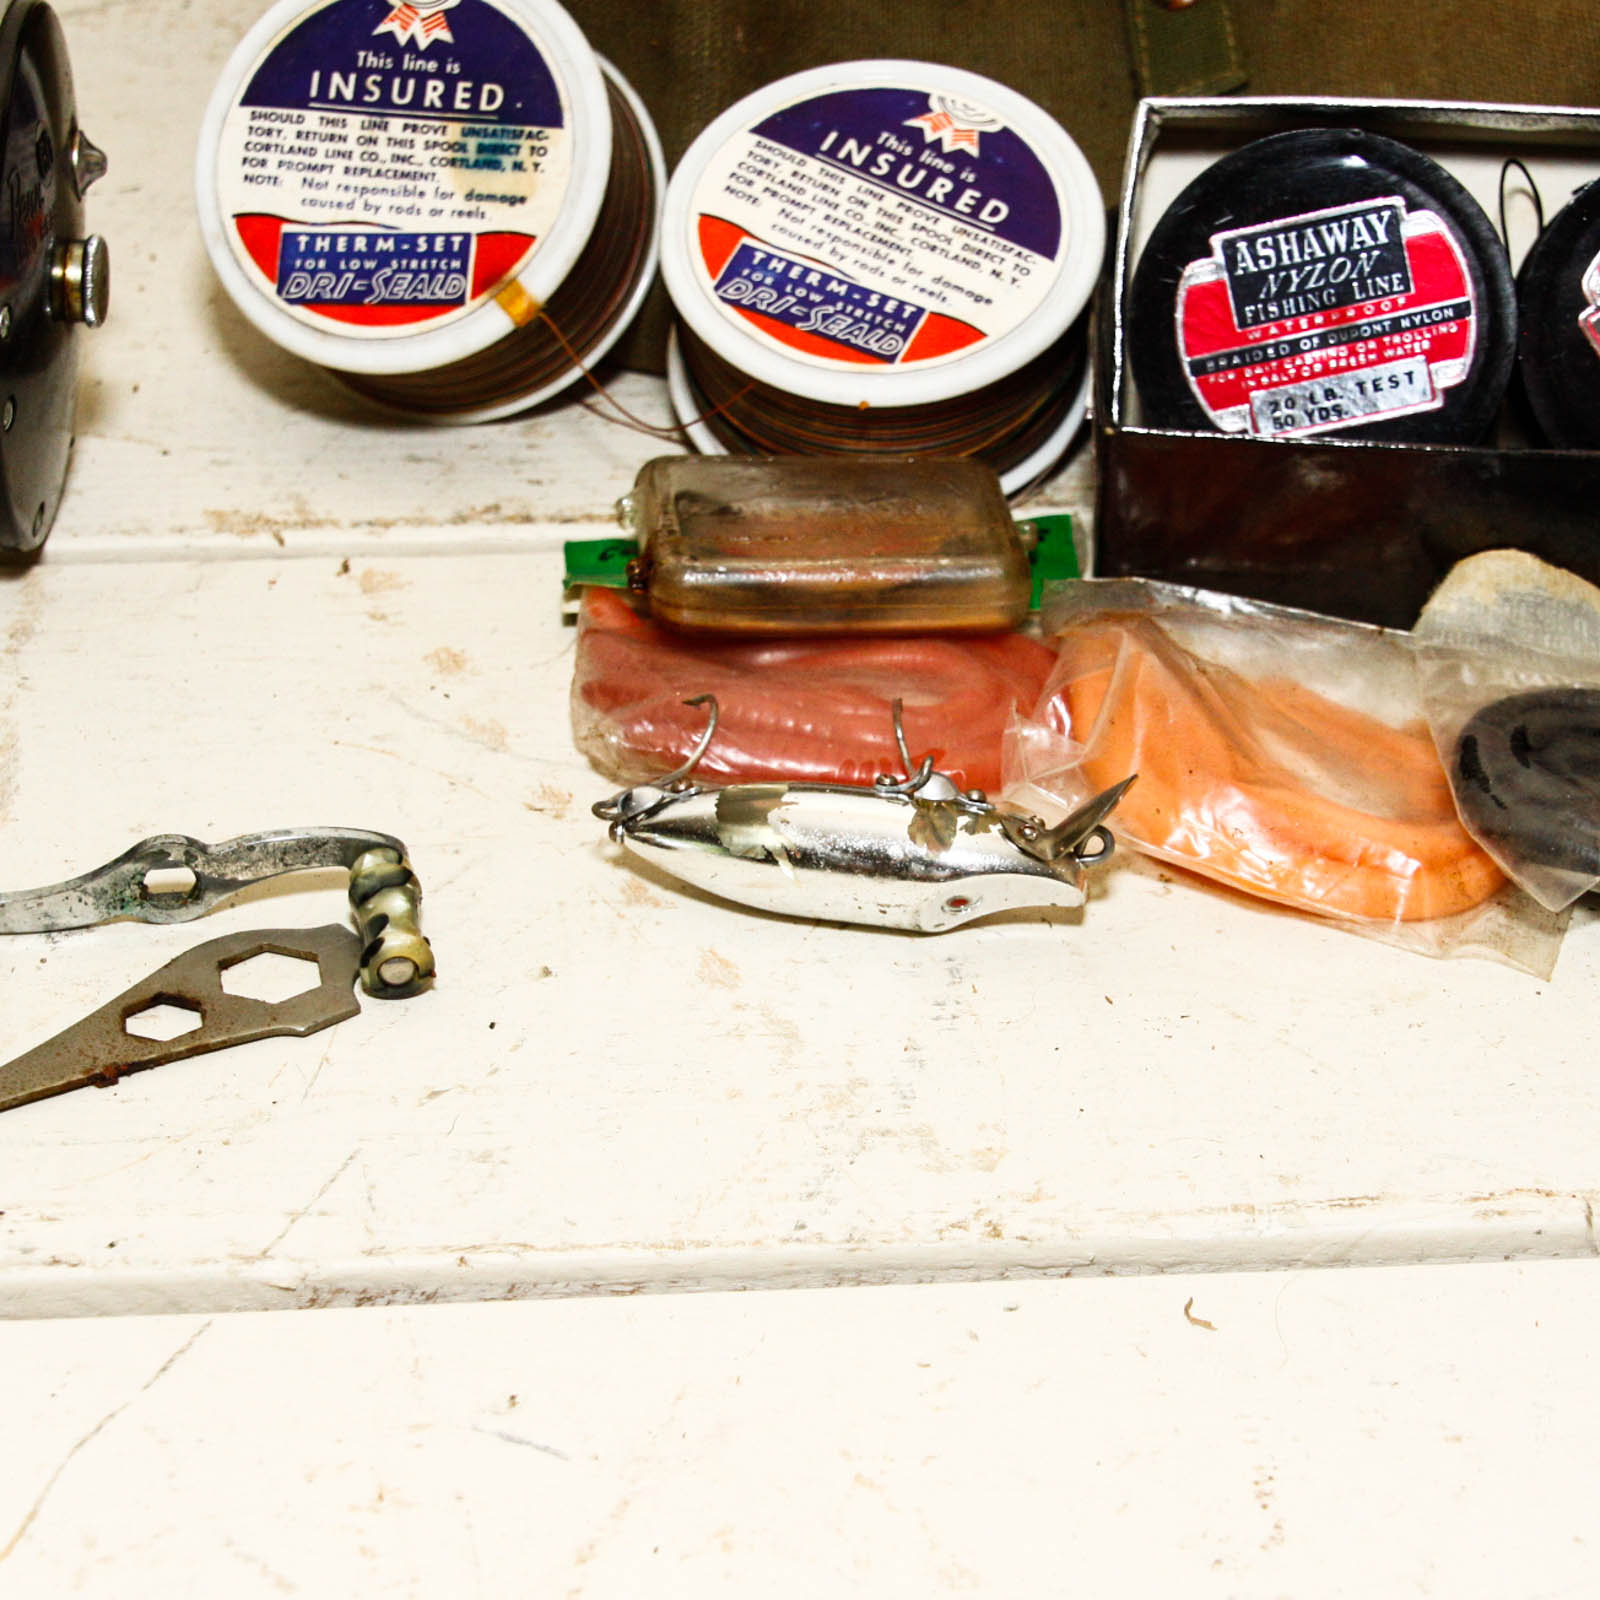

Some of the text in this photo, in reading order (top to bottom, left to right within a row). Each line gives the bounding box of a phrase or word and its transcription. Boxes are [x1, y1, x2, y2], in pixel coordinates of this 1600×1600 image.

[357, 51, 461, 75] This line is
[309, 70, 505, 112] INSURED
[248, 126, 548, 157] TORY, RETURN ON THIS SPOOL DIRECT TO
[250, 110, 550, 141] SHOULD THIS LINE PROVE UNSATISFAC-
[241, 157, 441, 183] FOR PROMPT REPLACEMENT.
[244, 141, 318, 157] CORTLAND
[325, 149, 353, 161] LINE
[430, 156, 506, 172] CORTLAND,
[512, 161, 527, 173] N.
[532, 162, 545, 174] Y.
[819, 130, 1010, 225] INSURED
[876, 131, 977, 183] This line is
[301, 177, 329, 191] Not
[337, 183, 426, 200] responsible
[434, 186, 456, 200] for
[464, 188, 528, 207] damage
[728, 172, 755, 187] FOR
[762, 187, 817, 215] PROMPT
[755, 140, 808, 168] SHOULD
[818, 167, 846, 185] THIS
[857, 185, 886, 202] LINE
[896, 202, 941, 226] PROVE
[301, 198, 356, 211] caused
[363, 200, 382, 215] by
[389, 202, 422, 216] rods
[429, 208, 444, 217] or
[737, 161, 807, 196] CORTLAND
[812, 195, 841, 211] LINE
[989, 269, 1006, 281] N.
[1010, 277, 1022, 289] Y.
[791, 170, 841, 197] RETURN
[847, 195, 870, 209] ON
[876, 207, 904, 225] THIS
[911, 223, 953, 246] SPOOL
[961, 243, 1006, 265] DIRECT
[1013, 263, 1031, 277] TO
[294, 258, 462, 271] FOR LOW STRETCH
[771, 223, 825, 249] caused
[829, 247, 847, 262] by
[853, 259, 886, 277] rods
[891, 276, 907, 285] or
[778, 208, 806, 225] Not
[810, 224, 896, 266] responsible
[903, 261, 924, 277] for
[931, 275, 993, 306] damage
[1234, 209, 1392, 276] ASHAWAY
[281, 267, 466, 305] DRI-SEALD
[742, 268, 907, 333] FOR LOW STRETCH
[1244, 272, 1405, 324] FISHING LINE
[717, 278, 904, 355] DRI-SEALD
[1205, 307, 1455, 372] BRAIDED OF DUPONT NYLON
[1246, 296, 1406, 340] WATERPROOF
[1208, 371, 1236, 384] FOR
[1283, 345, 1349, 369] CASTING
[1355, 339, 1378, 353] OR
[1382, 322, 1459, 346] TROLLING
[1260, 367, 1298, 386] SALT
[1301, 363, 1324, 378] OR
[1383, 339, 1431, 358] WATER
[1268, 370, 1415, 415] 20 LB. TEST
[1271, 402, 1350, 431] 50 YDS.
